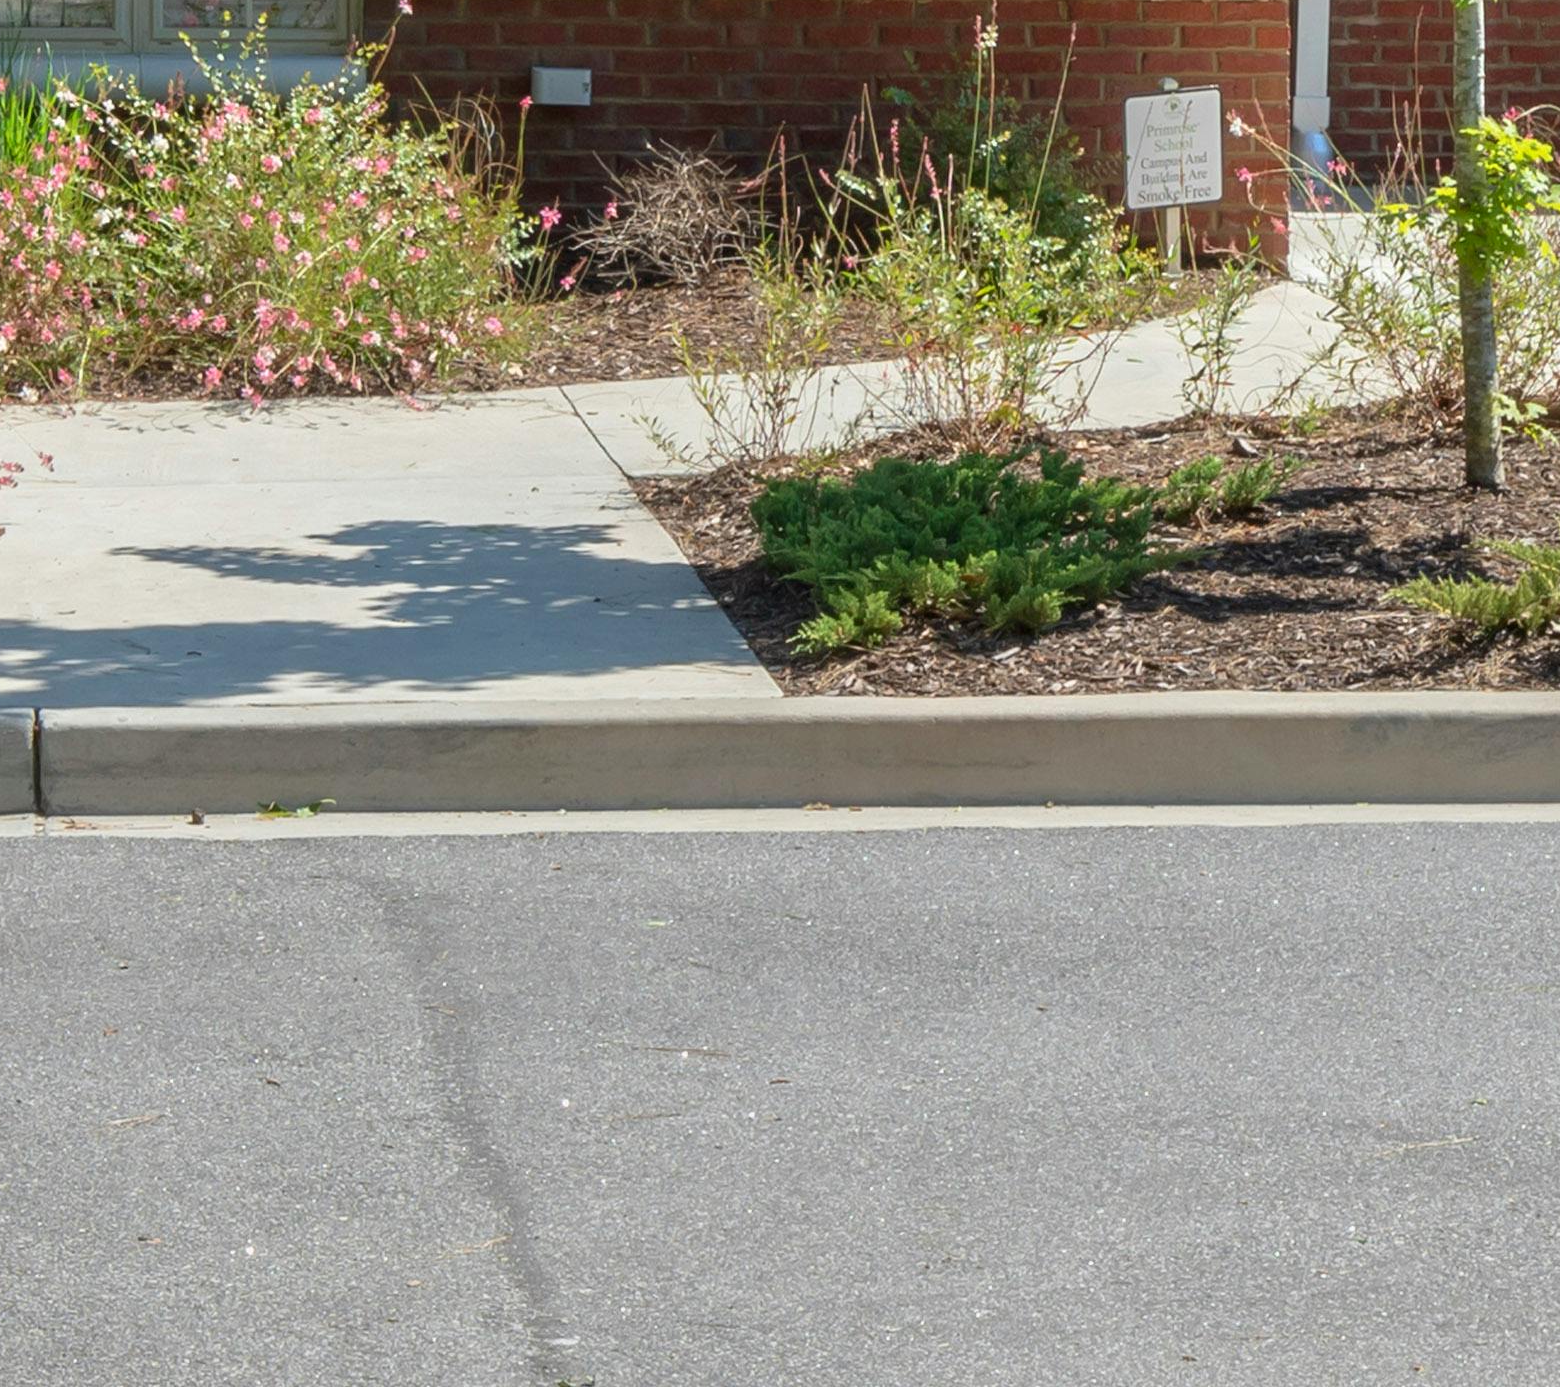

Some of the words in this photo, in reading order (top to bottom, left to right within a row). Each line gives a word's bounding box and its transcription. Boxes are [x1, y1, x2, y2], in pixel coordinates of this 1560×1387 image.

[1185, 151, 1208, 165] And
[1188, 170, 1209, 181] Are
[1138, 187, 1180, 204] Smoke
[1184, 185, 1212, 198] Free
